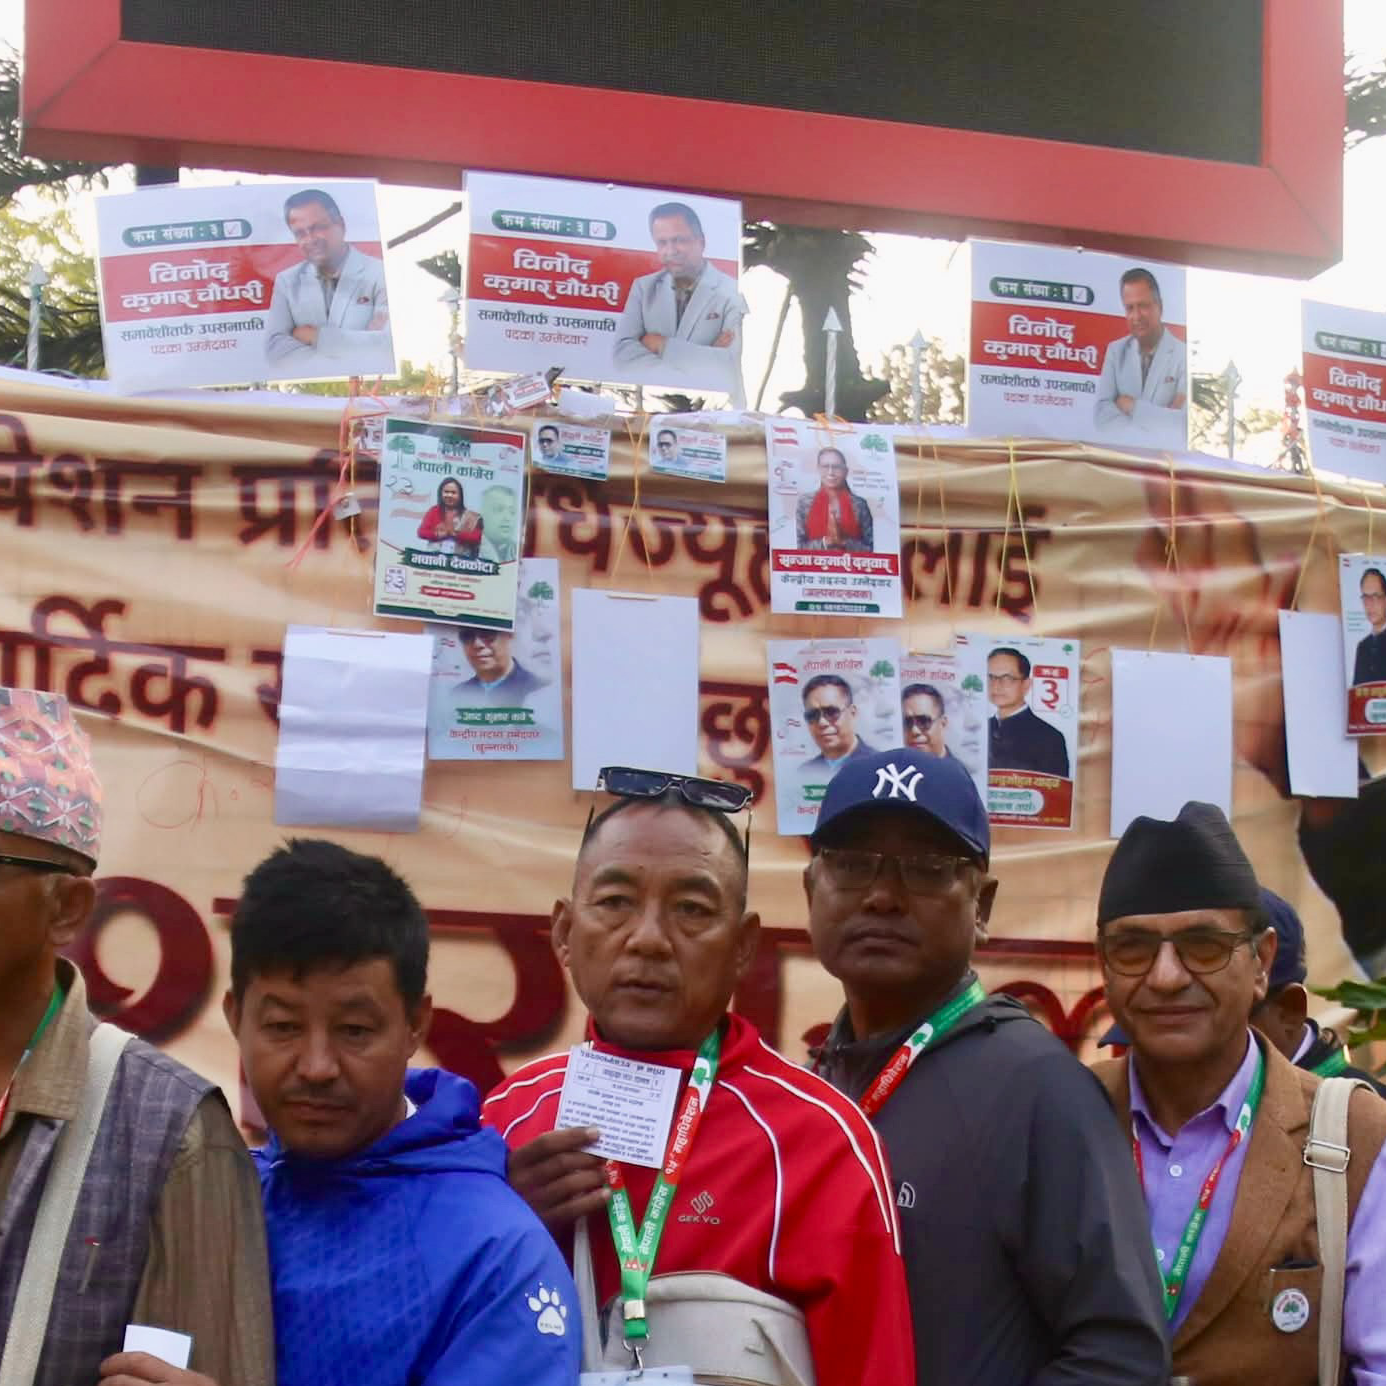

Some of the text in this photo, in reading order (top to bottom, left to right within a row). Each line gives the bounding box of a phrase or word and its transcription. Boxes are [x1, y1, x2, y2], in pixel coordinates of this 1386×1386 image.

[149, 258, 230, 284] विनोद
[513, 248, 592, 279] विनोद
[120, 279, 264, 312] कुमार चौधरी
[483, 272, 621, 305] कुमार चौधरी
[1008, 314, 1076, 344] विनोद
[983, 339, 1099, 369] कुमार चौधरी
[1328, 366, 1383, 396] विनोद
[412, 459, 495, 482] नेपाली कांग्रेस
[1041, 679, 1061, 709] ३
[872, 763, 924, 802] NY
[638, 1220, 657, 1256] नेपाली
[650, 1184, 670, 1220] कांग्रेस
[672, 1095, 700, 1154] महाधिवेशन
